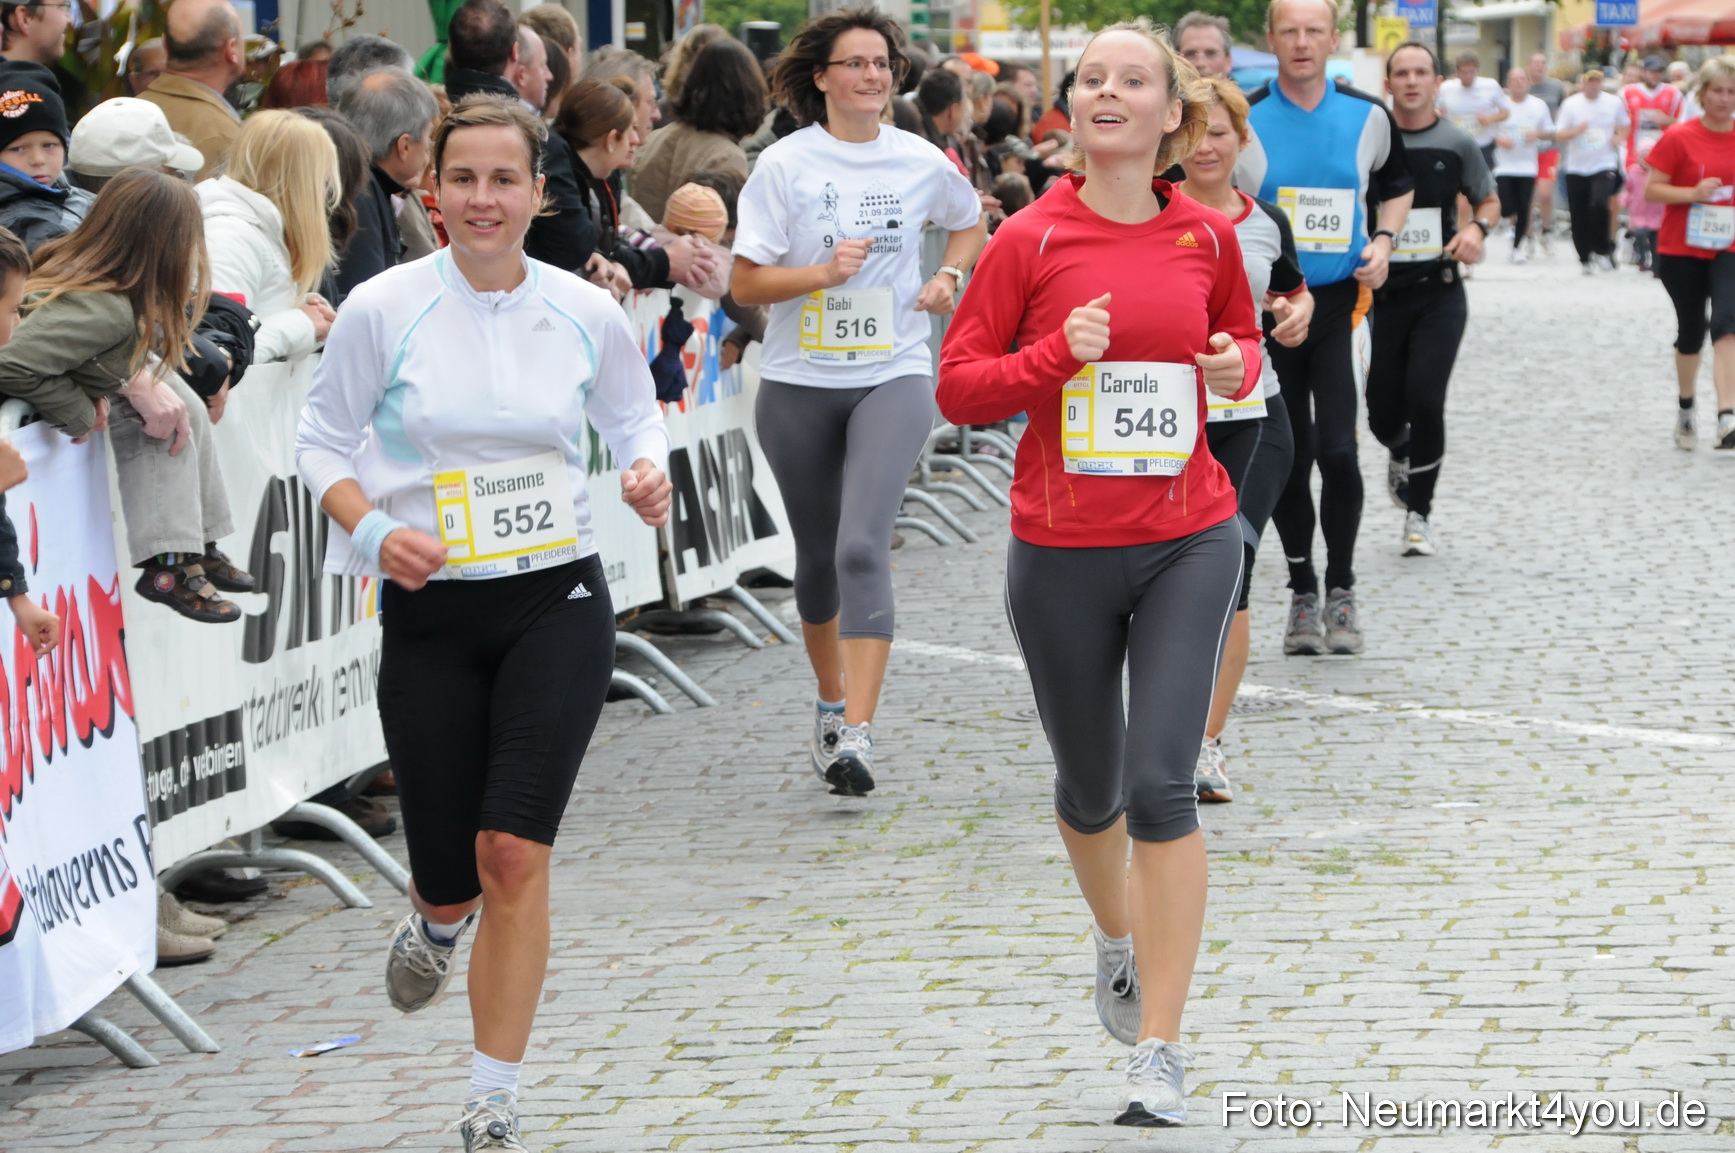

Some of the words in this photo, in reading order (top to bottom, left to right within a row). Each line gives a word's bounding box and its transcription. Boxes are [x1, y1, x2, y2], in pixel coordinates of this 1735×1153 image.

[1600, 2, 1636, 20] TAXI
[1299, 193, 1333, 207] Robert
[859, 207, 903, 217] 21.09.2008
[1305, 214, 1341, 231] 649
[1175, 240, 1198, 248] adidas
[827, 296, 852, 311] Gabi
[804, 316, 811, 327] D
[835, 317, 877, 339] 516
[1101, 372, 1159, 393] Carola
[1068, 405, 1076, 420] D
[1114, 407, 1178, 438] 548
[474, 472, 545, 497] Susanne
[445, 514, 454, 529] D
[493, 500, 554, 538] 552
[530, 545, 577, 563] PFLEIDERER
[567, 591, 592, 600] adidas
